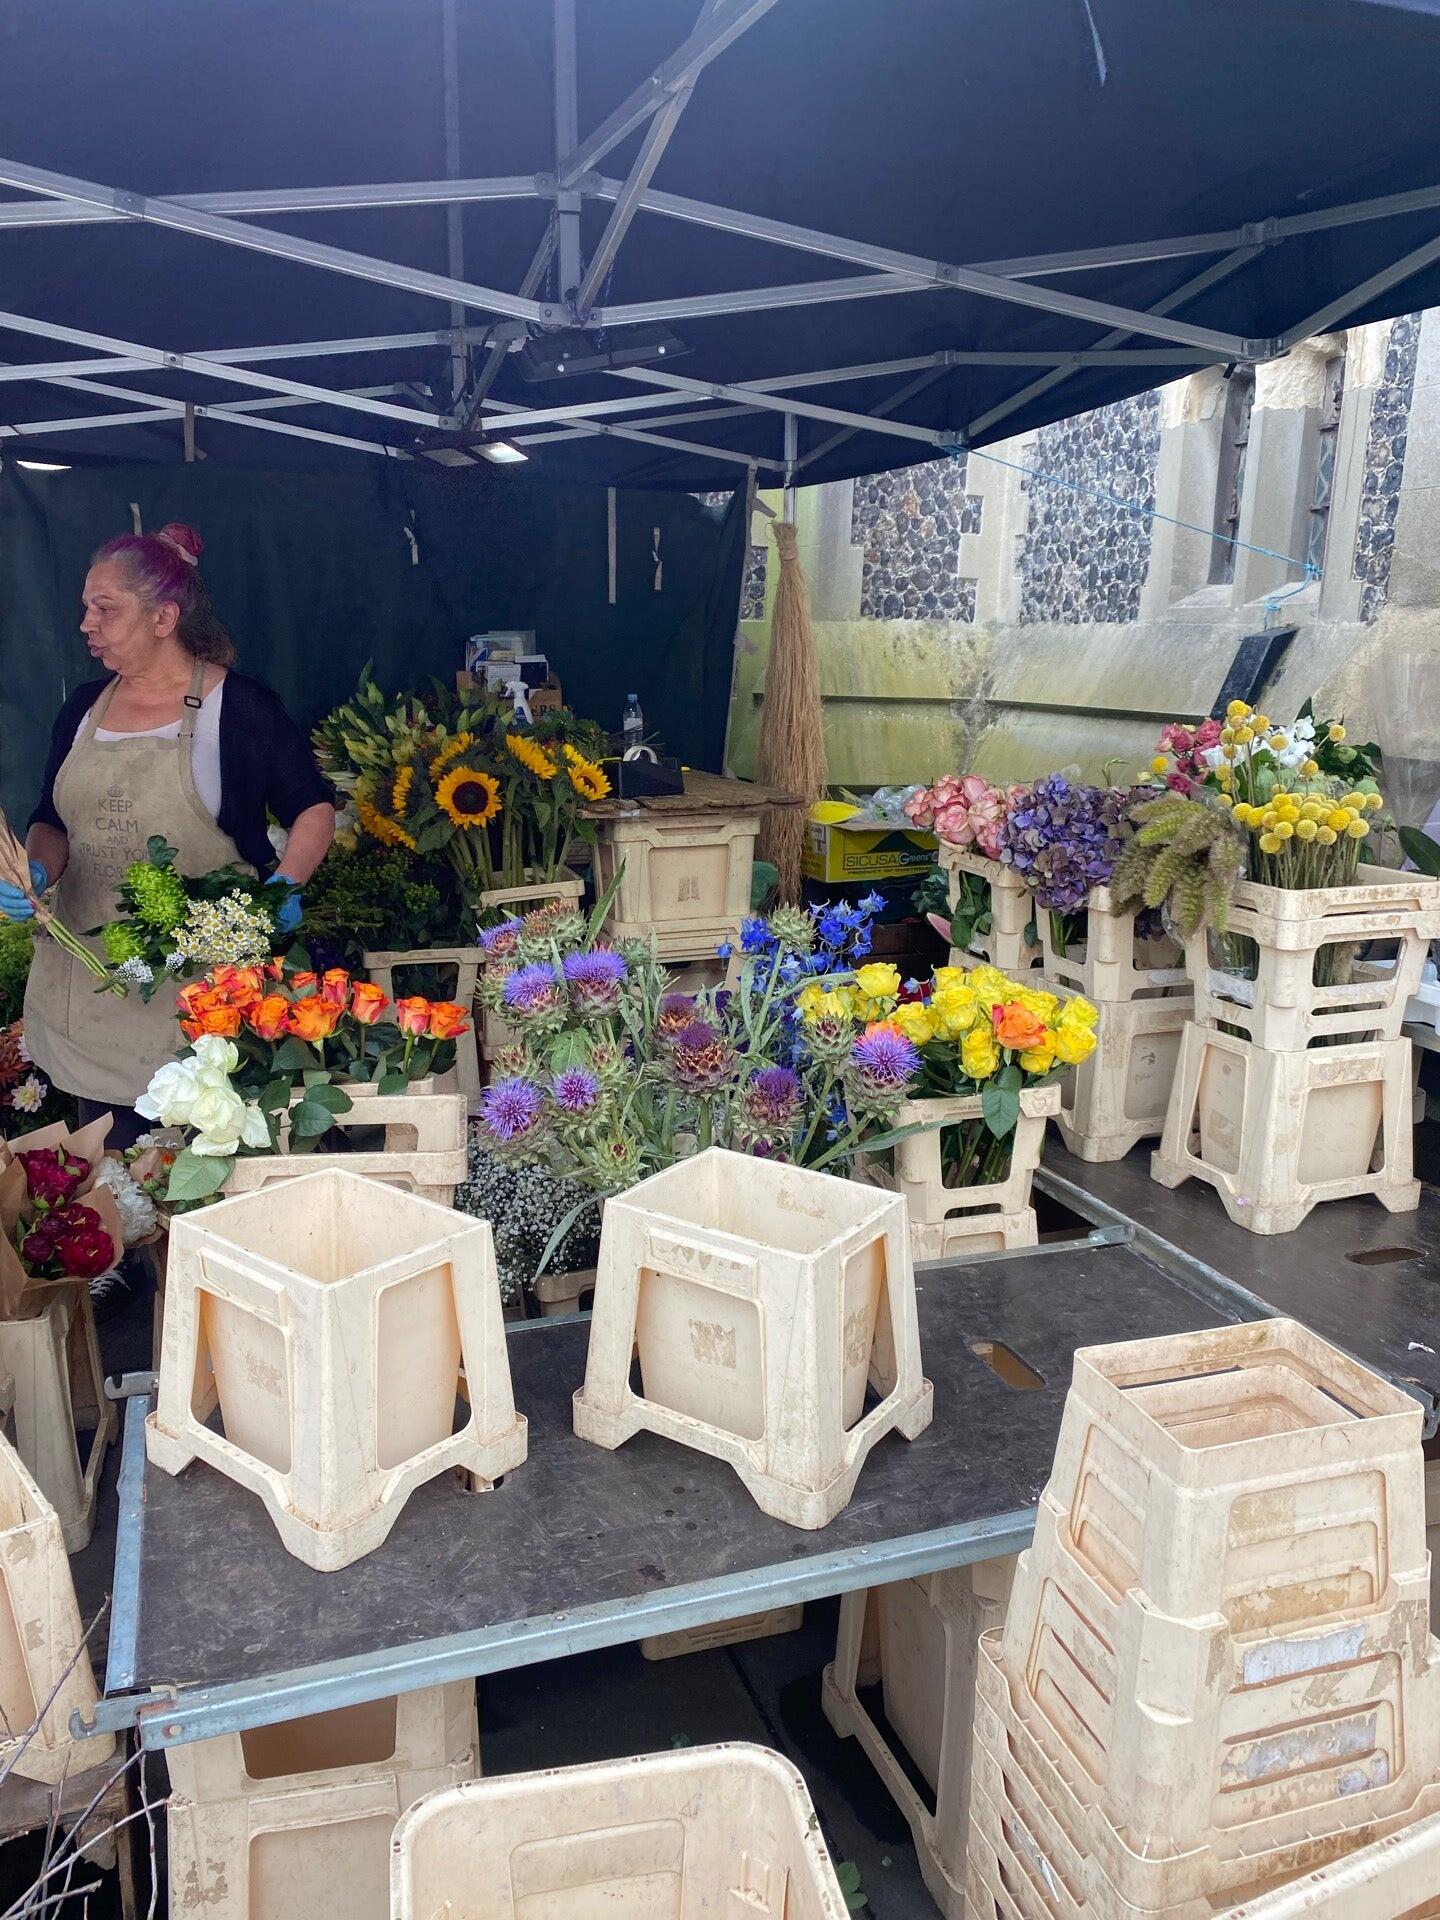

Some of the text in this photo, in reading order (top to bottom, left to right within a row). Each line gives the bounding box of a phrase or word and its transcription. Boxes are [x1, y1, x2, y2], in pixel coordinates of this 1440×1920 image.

[98, 798, 133, 813] KEEP
[95, 817, 139, 833] CALM
[107, 836, 128, 845] AND
[80, 842, 117, 859] TRUST
[846, 854, 897, 867] SICUSA
[93, 863, 124, 879] FLOR
